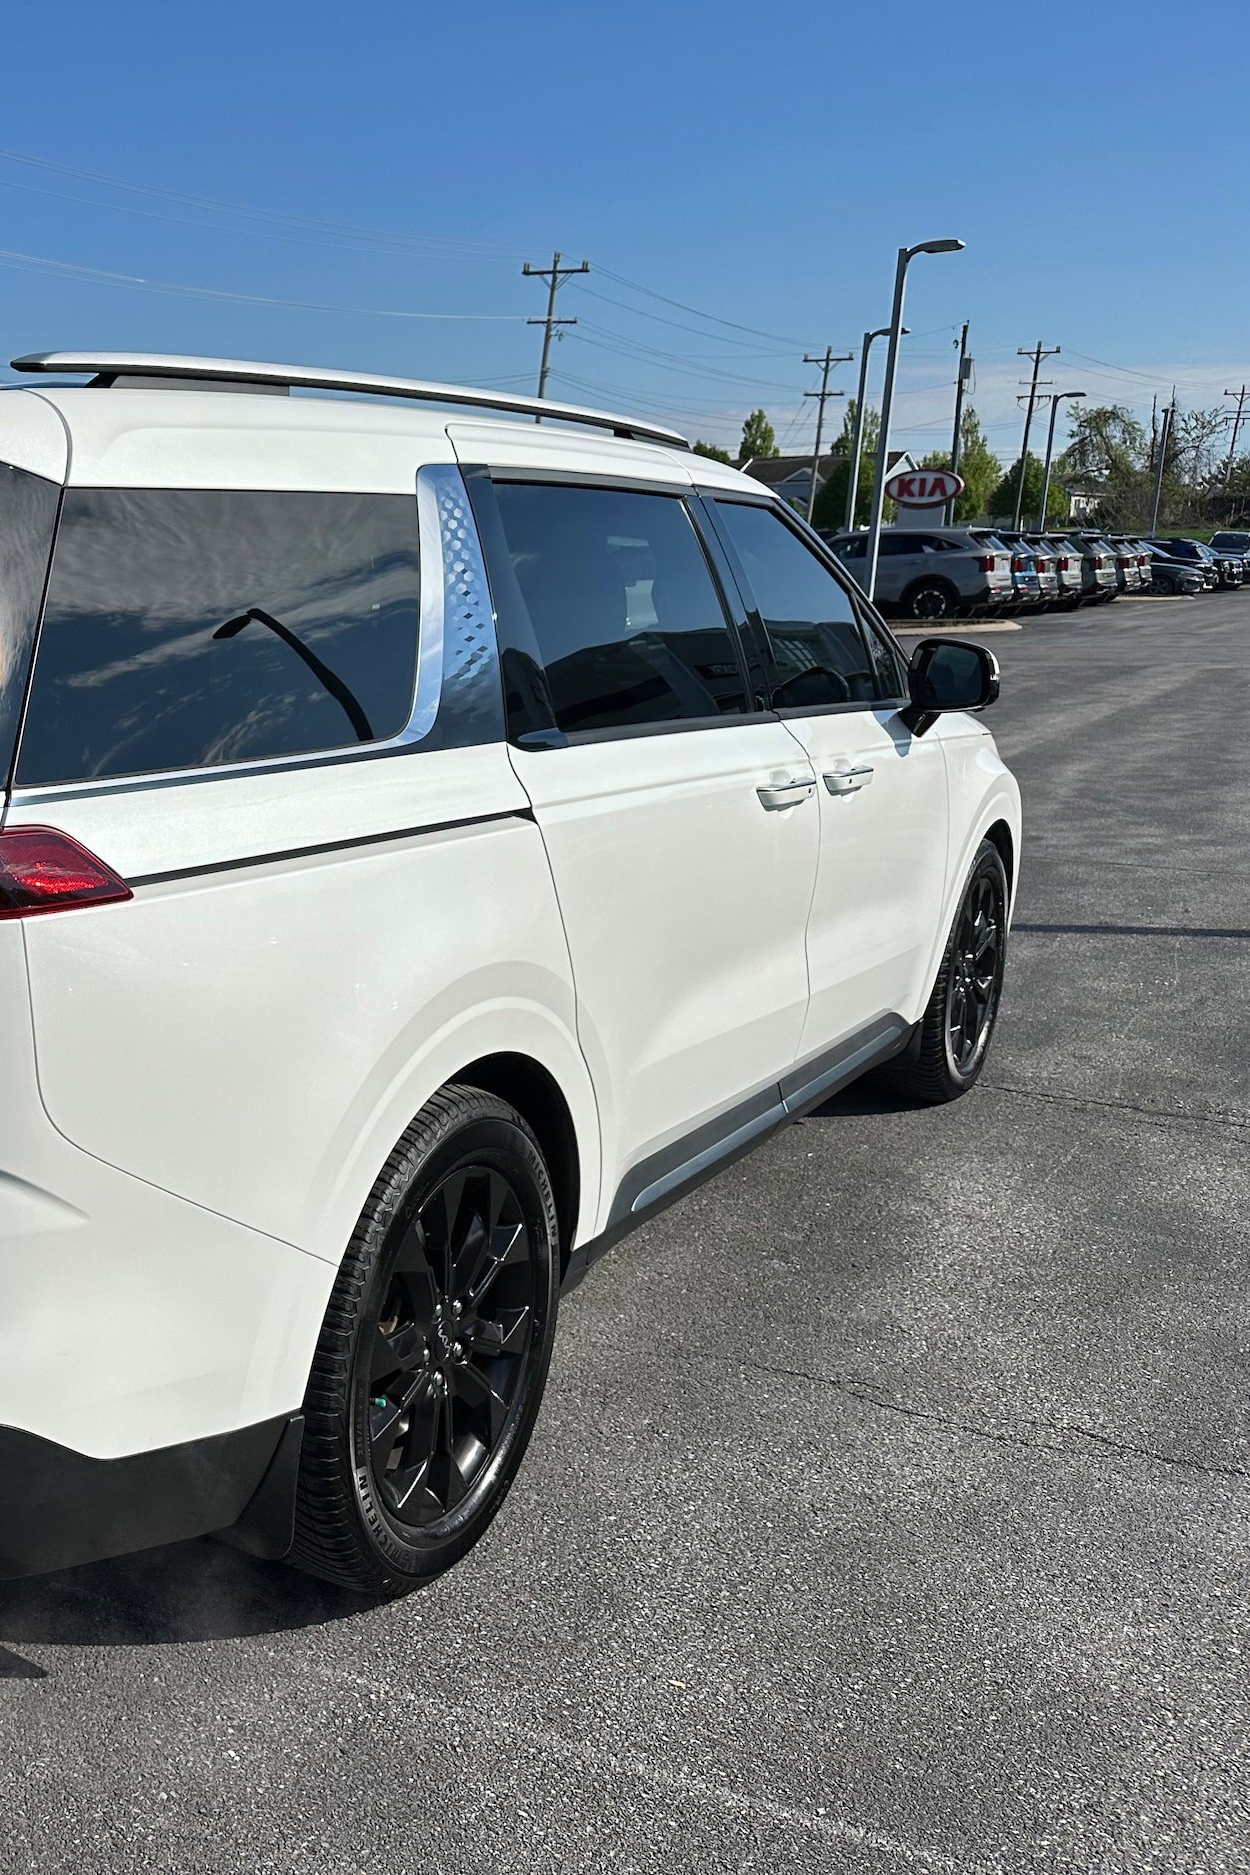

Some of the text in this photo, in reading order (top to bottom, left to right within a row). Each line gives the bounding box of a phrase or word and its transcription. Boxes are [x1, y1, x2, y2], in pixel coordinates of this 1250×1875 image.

[896, 477, 948, 498] KIA
[526, 1149, 559, 1238] MICHELIN
[357, 1473, 402, 1559] MICHELIN
